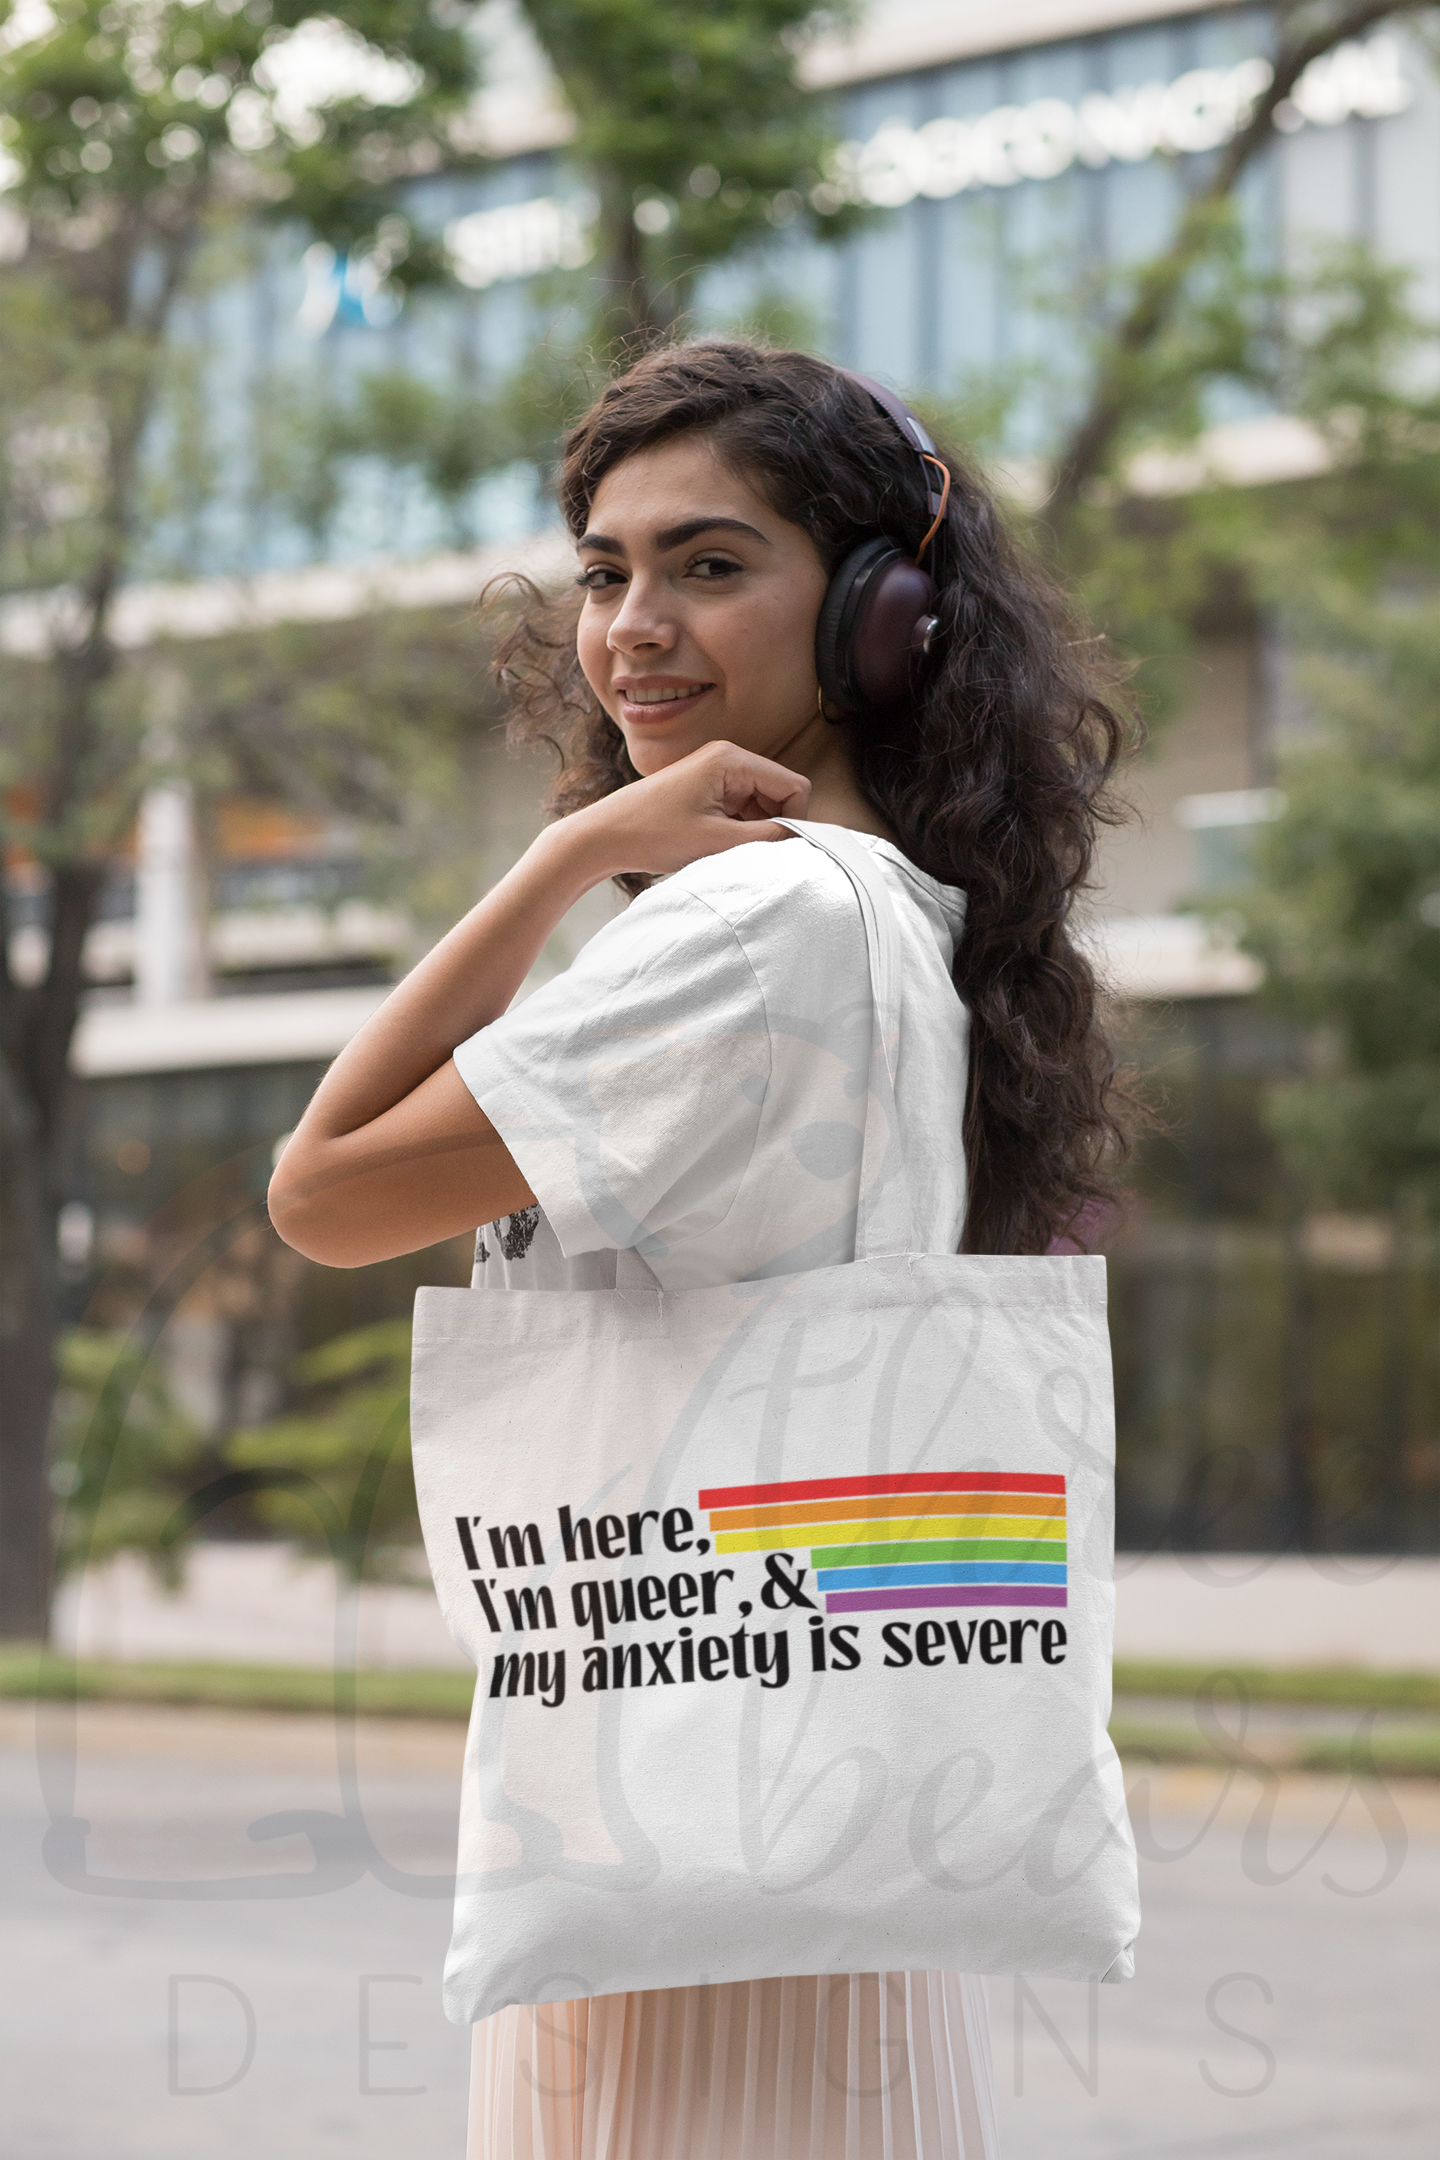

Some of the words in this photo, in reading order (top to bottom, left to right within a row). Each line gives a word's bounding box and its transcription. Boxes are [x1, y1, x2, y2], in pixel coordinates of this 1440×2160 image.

[454, 1515, 546, 1571] I'm
[557, 1504, 711, 1563] here,
[472, 1578, 558, 1633] I'm
[760, 1552, 819, 1610] &
[488, 1649, 567, 1708] my
[581, 1622, 790, 1689] anxiety
[808, 1615, 861, 1672] is
[881, 1618, 1068, 1668] severe
